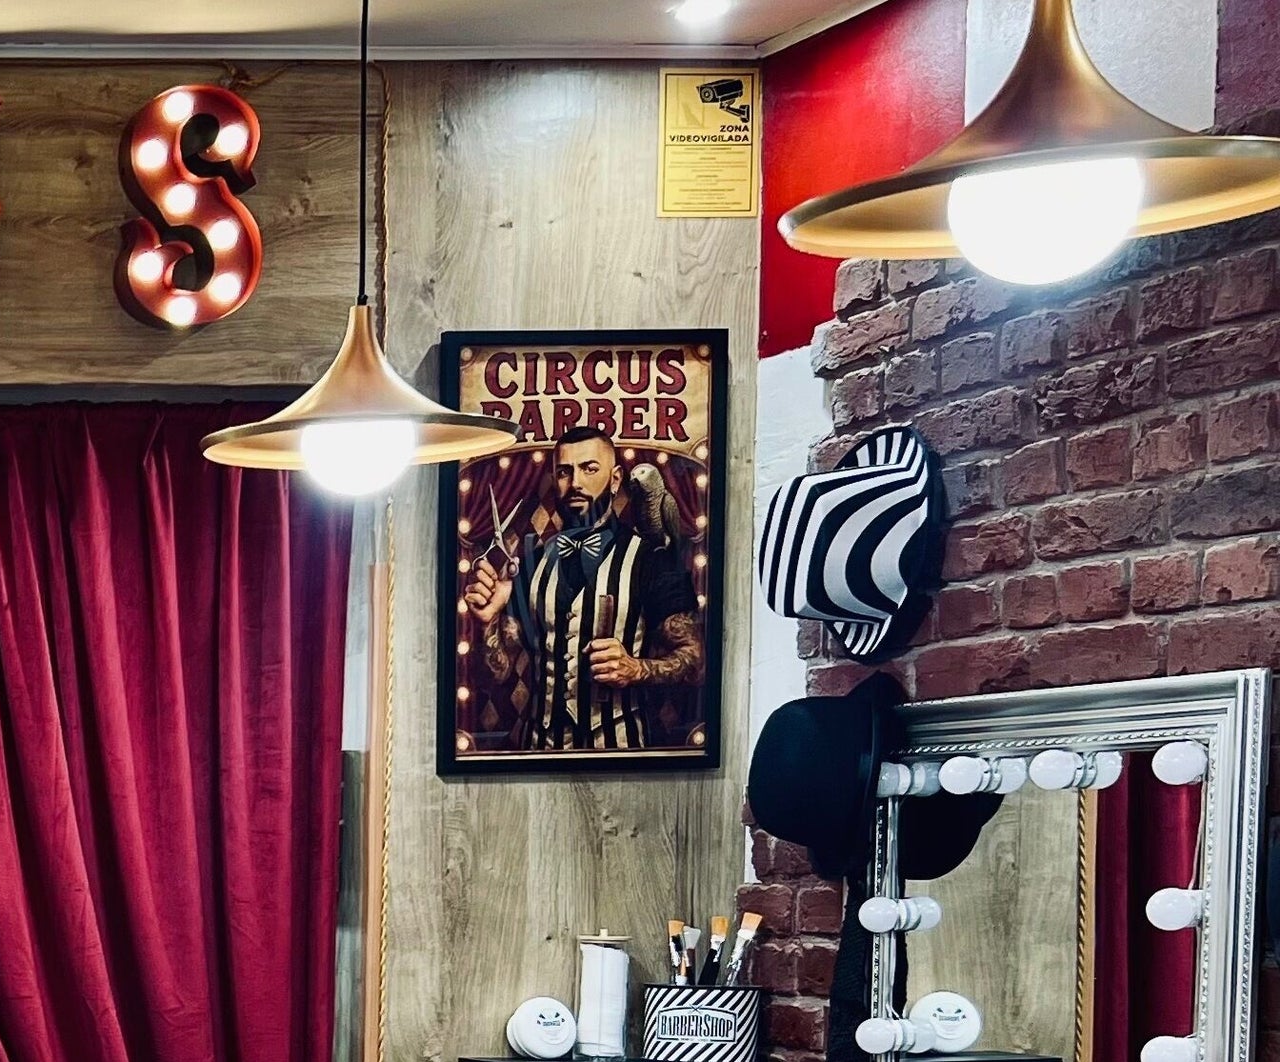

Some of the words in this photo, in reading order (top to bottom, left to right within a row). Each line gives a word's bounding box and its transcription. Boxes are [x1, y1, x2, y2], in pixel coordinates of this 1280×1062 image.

[720, 124, 750, 133] ZONA
[669, 134, 750, 143] VIDEOVIGILADA
[484, 349, 687, 399] CIRCUS
[660, 1013, 733, 1038] BARBERSHOP
